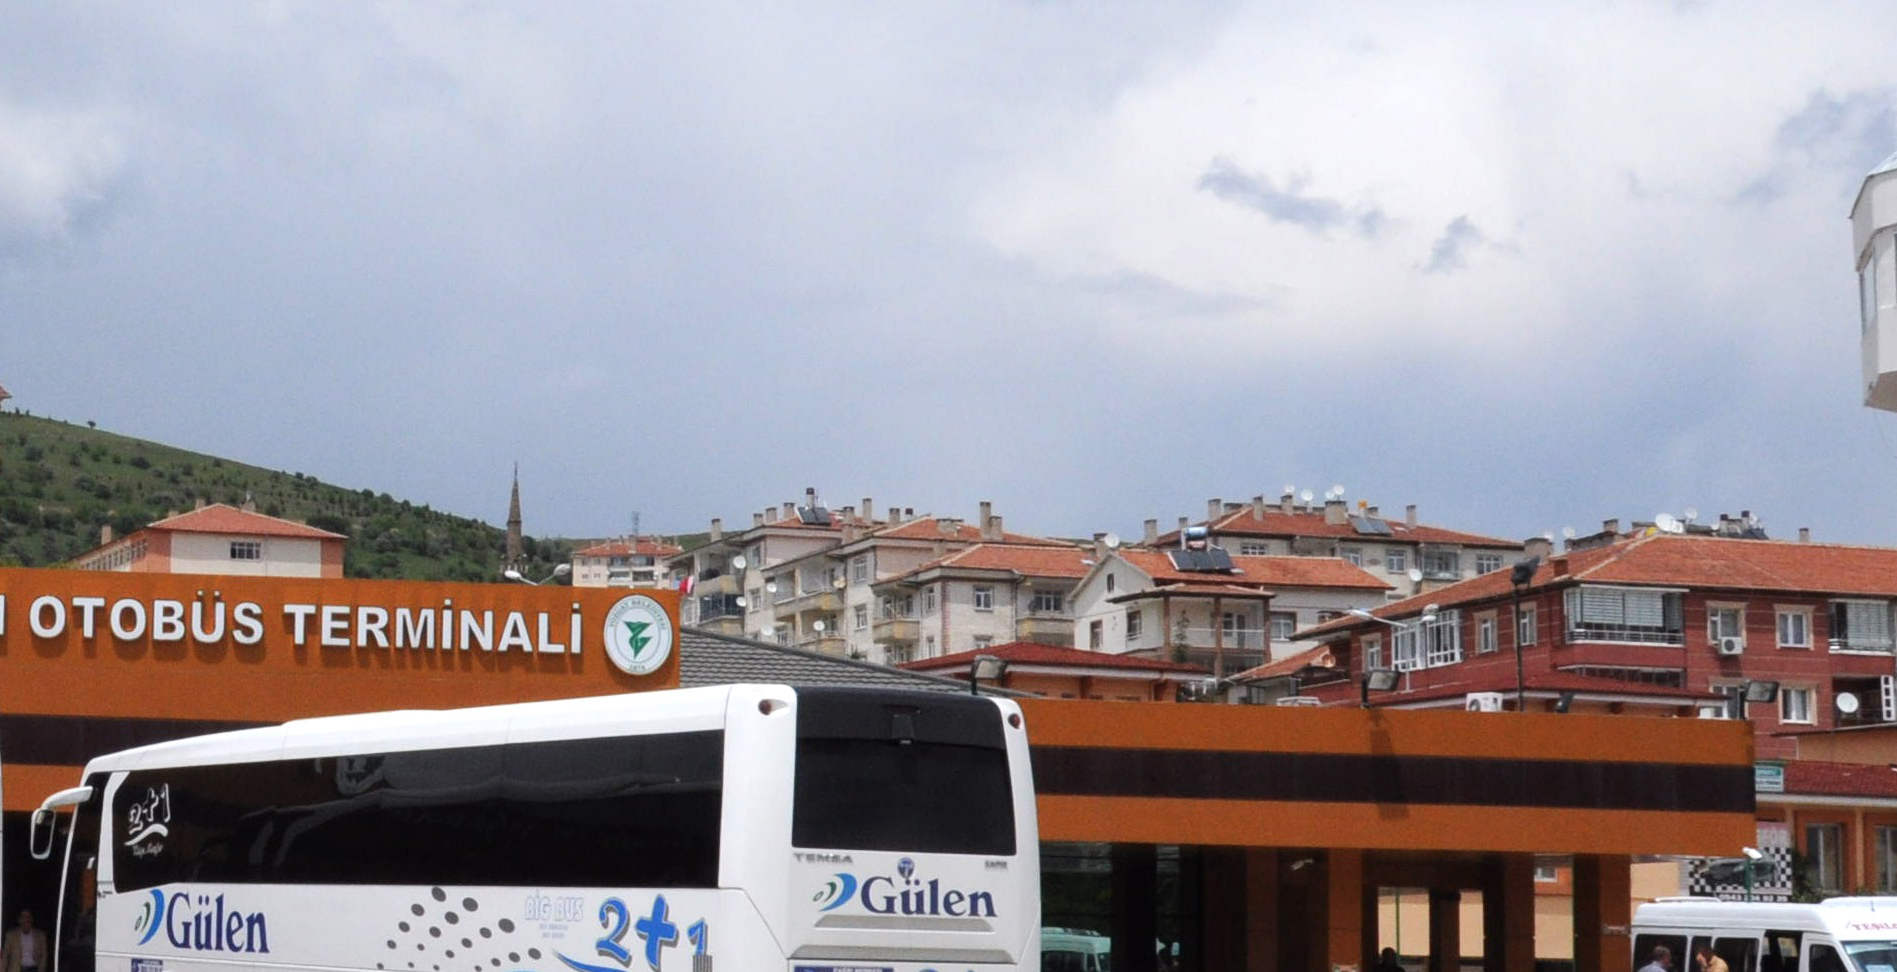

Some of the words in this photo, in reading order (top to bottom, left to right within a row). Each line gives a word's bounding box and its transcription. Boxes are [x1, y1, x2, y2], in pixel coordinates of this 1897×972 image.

[28, 590, 264, 645] OTOBÜS
[284, 598, 582, 654] TERMİNALİ
[793, 853, 854, 864] TEMSA
[554, 896, 585, 922] BUS
[861, 876, 998, 917] Gülen
[166, 892, 270, 953] Gülen
